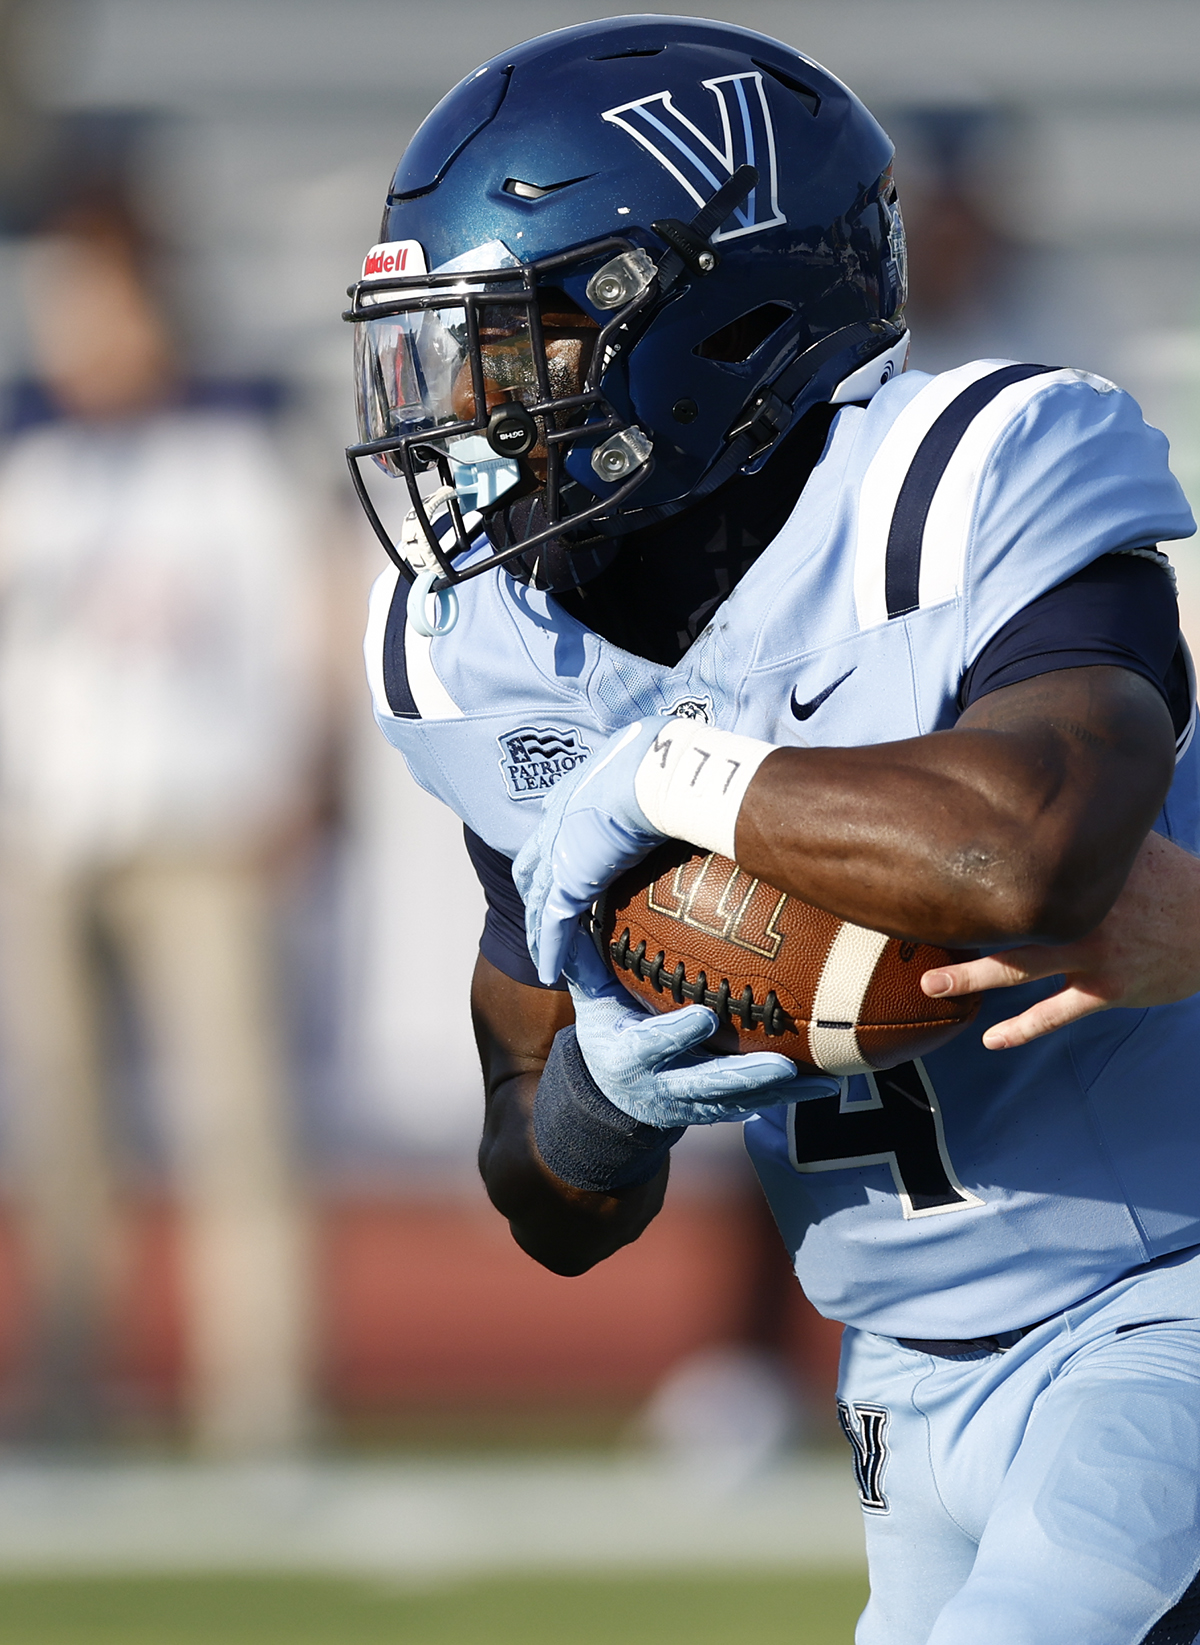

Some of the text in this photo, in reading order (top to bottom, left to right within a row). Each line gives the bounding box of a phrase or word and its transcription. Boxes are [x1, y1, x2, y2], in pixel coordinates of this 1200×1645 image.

[601, 71, 787, 243] V
[508, 754, 588, 779] PATRIOT
[512, 771, 568, 792] LEAG
[786, 1057, 987, 1220] 4
[838, 1402, 887, 1511] V
